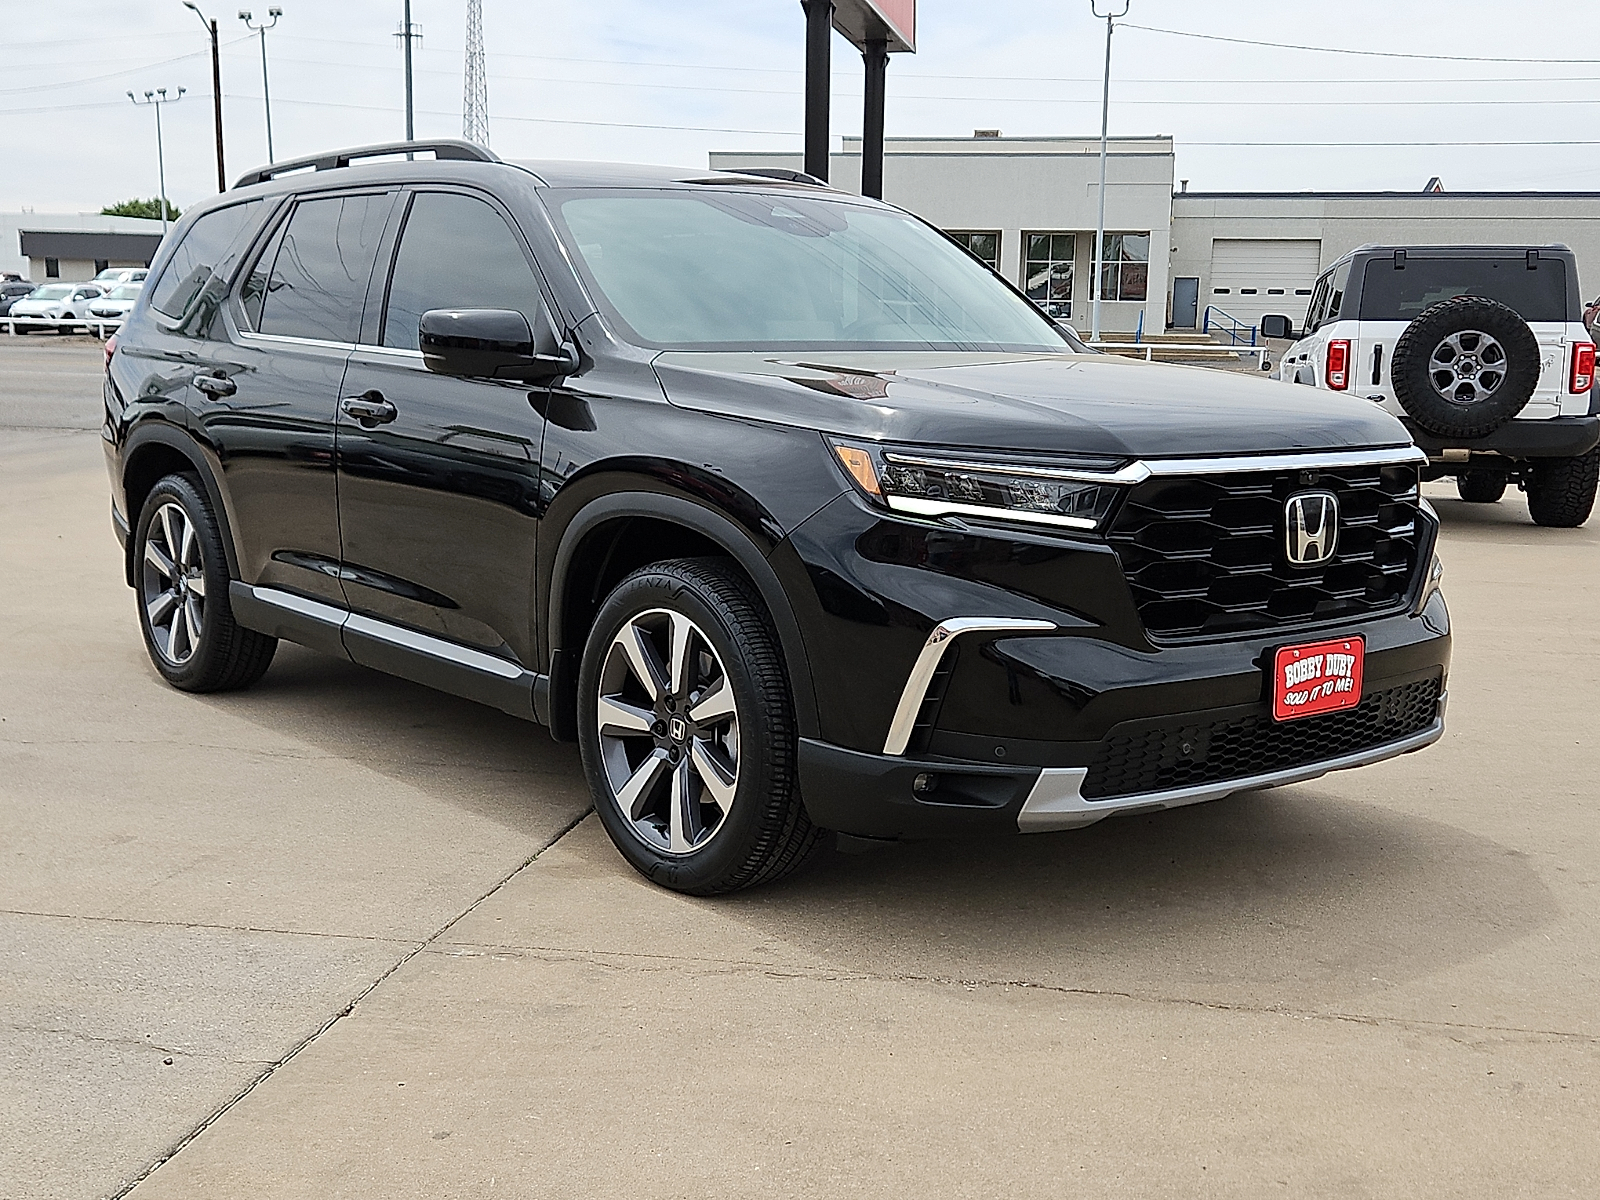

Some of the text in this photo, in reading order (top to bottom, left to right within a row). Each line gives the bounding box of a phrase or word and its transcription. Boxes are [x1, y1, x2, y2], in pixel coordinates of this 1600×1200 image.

[1285, 653, 1356, 689] BOBBY DUBY
[1284, 678, 1354, 705] SOLD IT TO ME!
